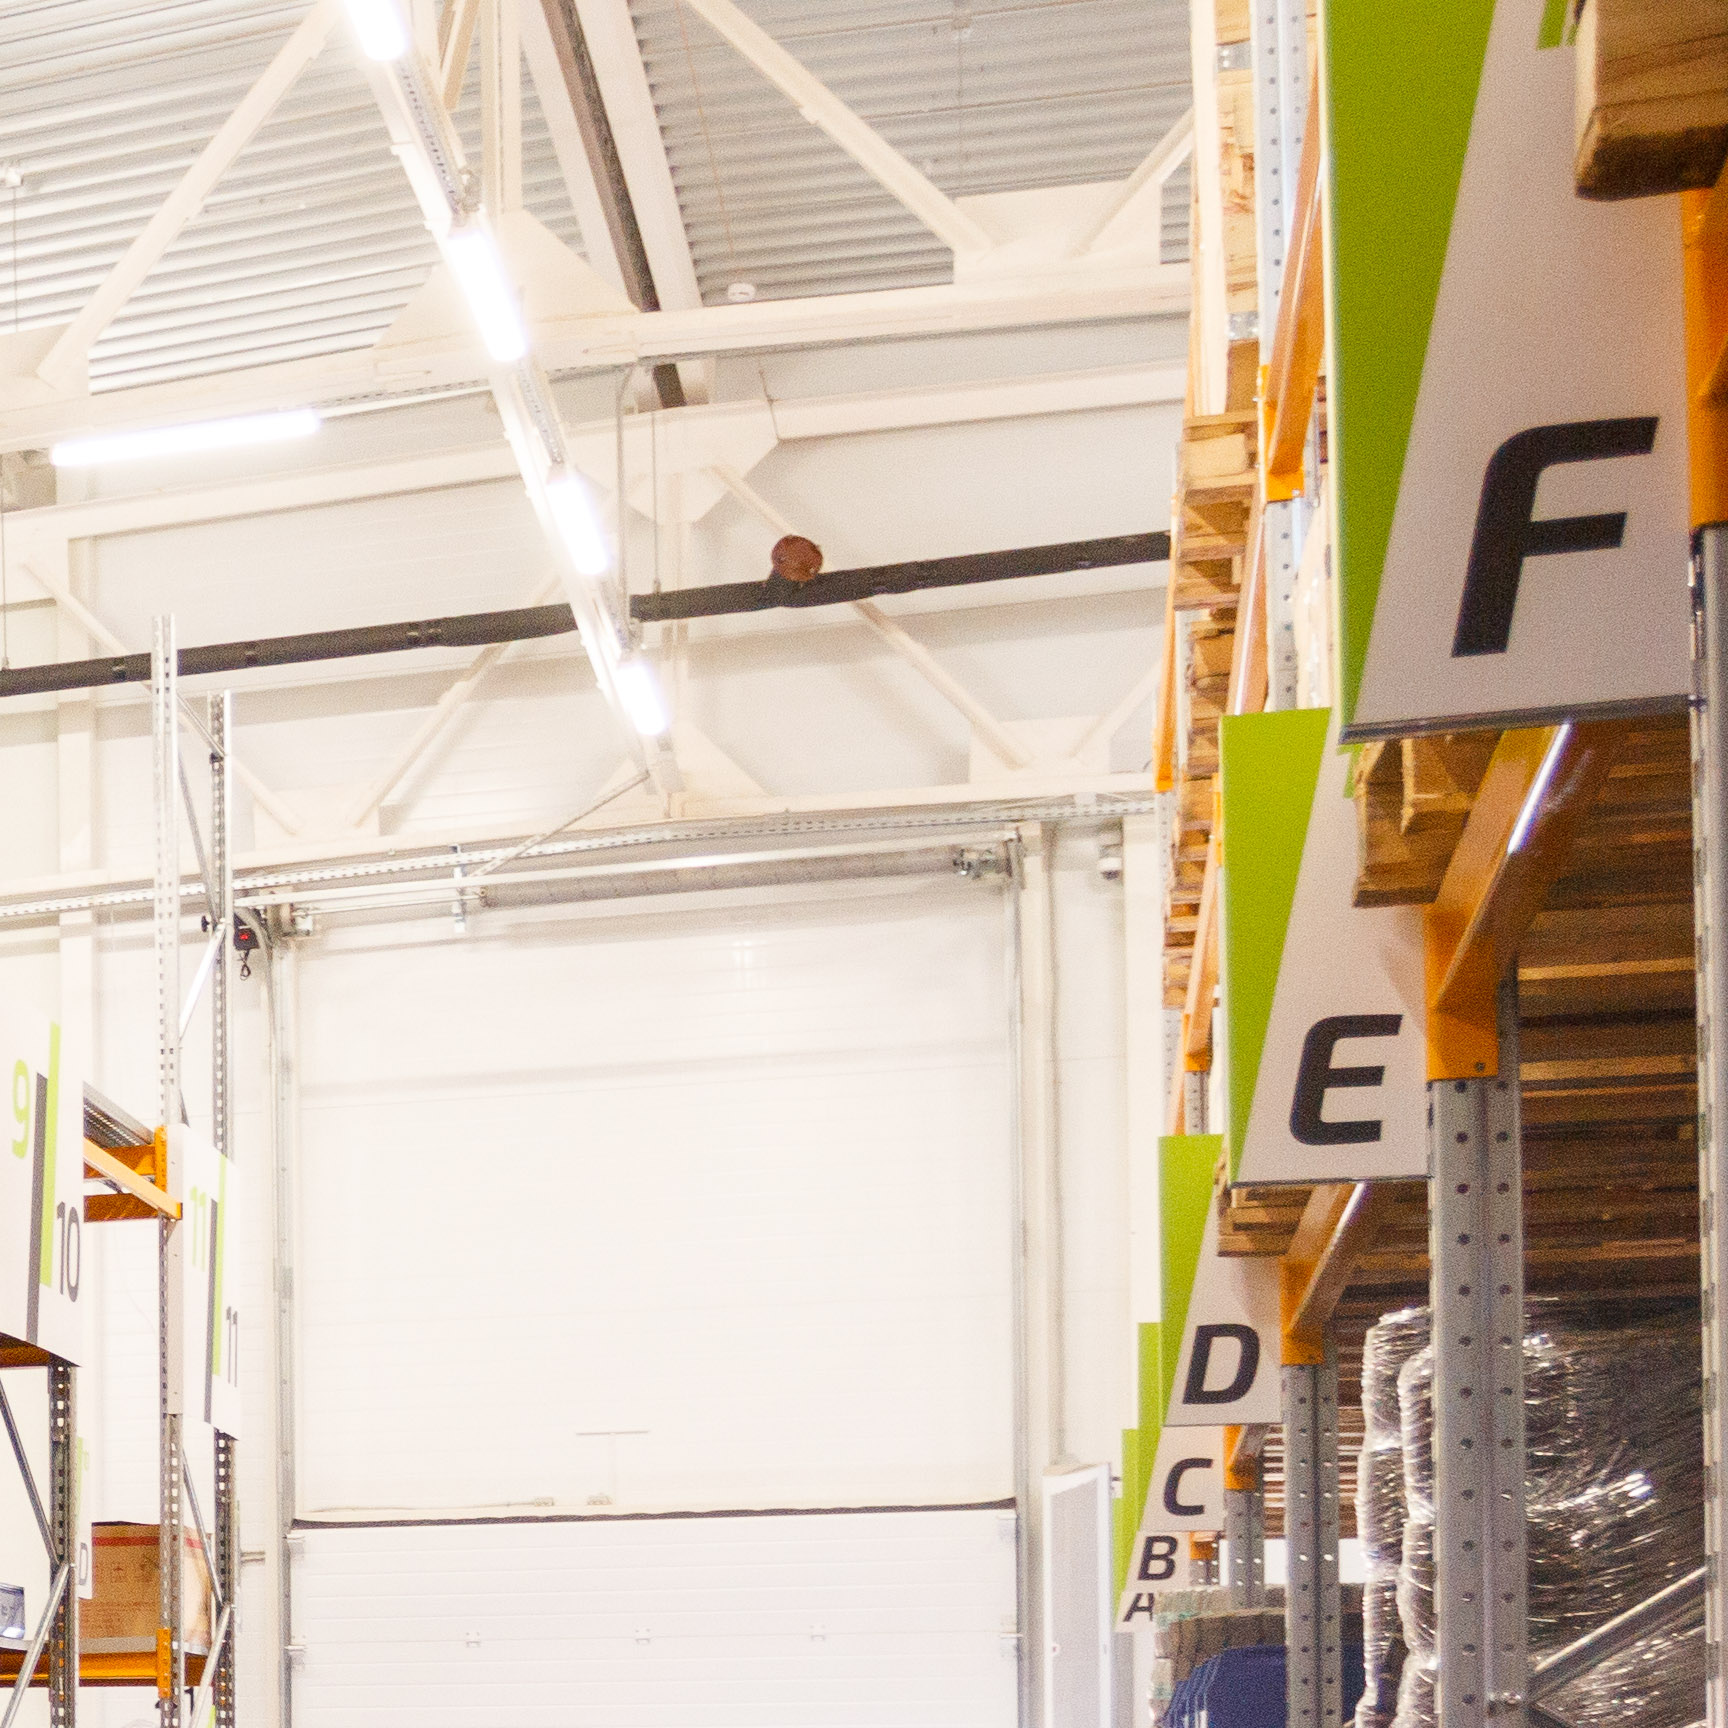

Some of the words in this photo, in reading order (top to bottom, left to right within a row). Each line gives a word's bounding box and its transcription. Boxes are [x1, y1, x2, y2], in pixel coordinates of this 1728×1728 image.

[1451, 416, 1660, 658] F
[12, 1059, 30, 1159] 9
[1289, 1014, 1403, 1146] E
[56, 1201, 81, 1303] 10
[189, 1184, 207, 1273] 11
[226, 1305, 238, 1388] 11
[1182, 1323, 1262, 1406] D
[1163, 1457, 1214, 1516] C
[78, 1542, 88, 1586] D
[1138, 1535, 1178, 1581] B
[1123, 1592, 1156, 1622] A
